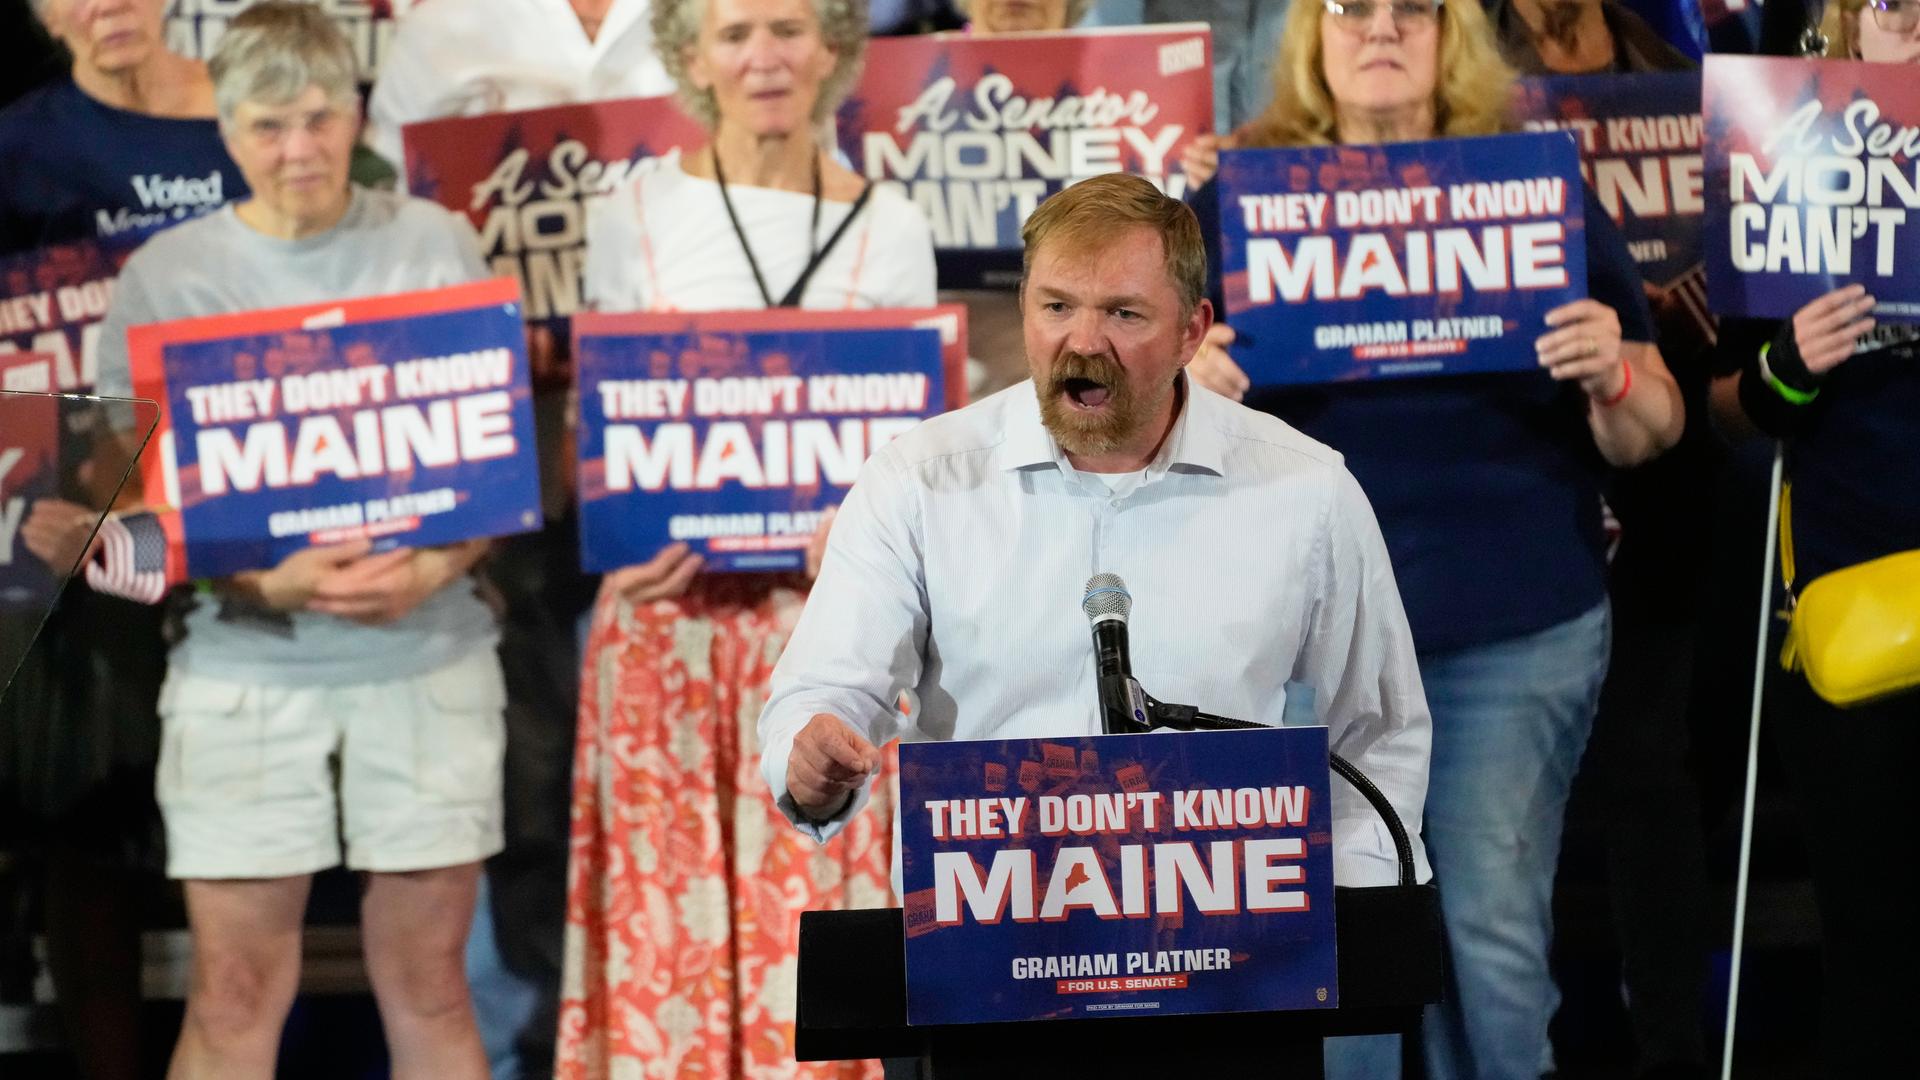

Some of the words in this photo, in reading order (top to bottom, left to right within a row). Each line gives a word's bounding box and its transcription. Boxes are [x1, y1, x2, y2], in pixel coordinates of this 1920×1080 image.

[897, 76, 959, 133] A
[963, 72, 1159, 132] Senator
[1762, 98, 1824, 156] A
[470, 147, 534, 210] A
[862, 124, 1184, 181] MONEY
[1728, 151, 1920, 209] MON
[130, 170, 223, 209] Voted
[900, 179, 1048, 249] AN'T
[1238, 193, 1327, 232] THEY
[1334, 185, 1443, 228] DON'T
[1449, 176, 1565, 222] KNOW
[1245, 220, 1569, 303] MAINE
[1729, 202, 1906, 277] CAN'T
[1314, 320, 1408, 350] GRAHAM
[1411, 315, 1504, 341] PLATNER
[185, 378, 276, 425] THEY
[281, 363, 388, 415] DON'T
[394, 347, 513, 398] KNOW
[597, 378, 689, 420] THEY
[694, 374, 803, 416] DON'T
[808, 372, 927, 412] KNOW
[195, 390, 517, 496] MAINE
[925, 796, 1029, 840] THEY
[1039, 791, 1161, 836] DON'T
[1174, 785, 1308, 831] KNOW
[933, 837, 1309, 924] MAINE
[1012, 953, 1118, 980] GRAHAM
[1126, 948, 1232, 975] PLATNER
[1068, 981, 1095, 992] FOR
[1098, 979, 1122, 990] U.S.
[1126, 977, 1177, 989] SENATE
